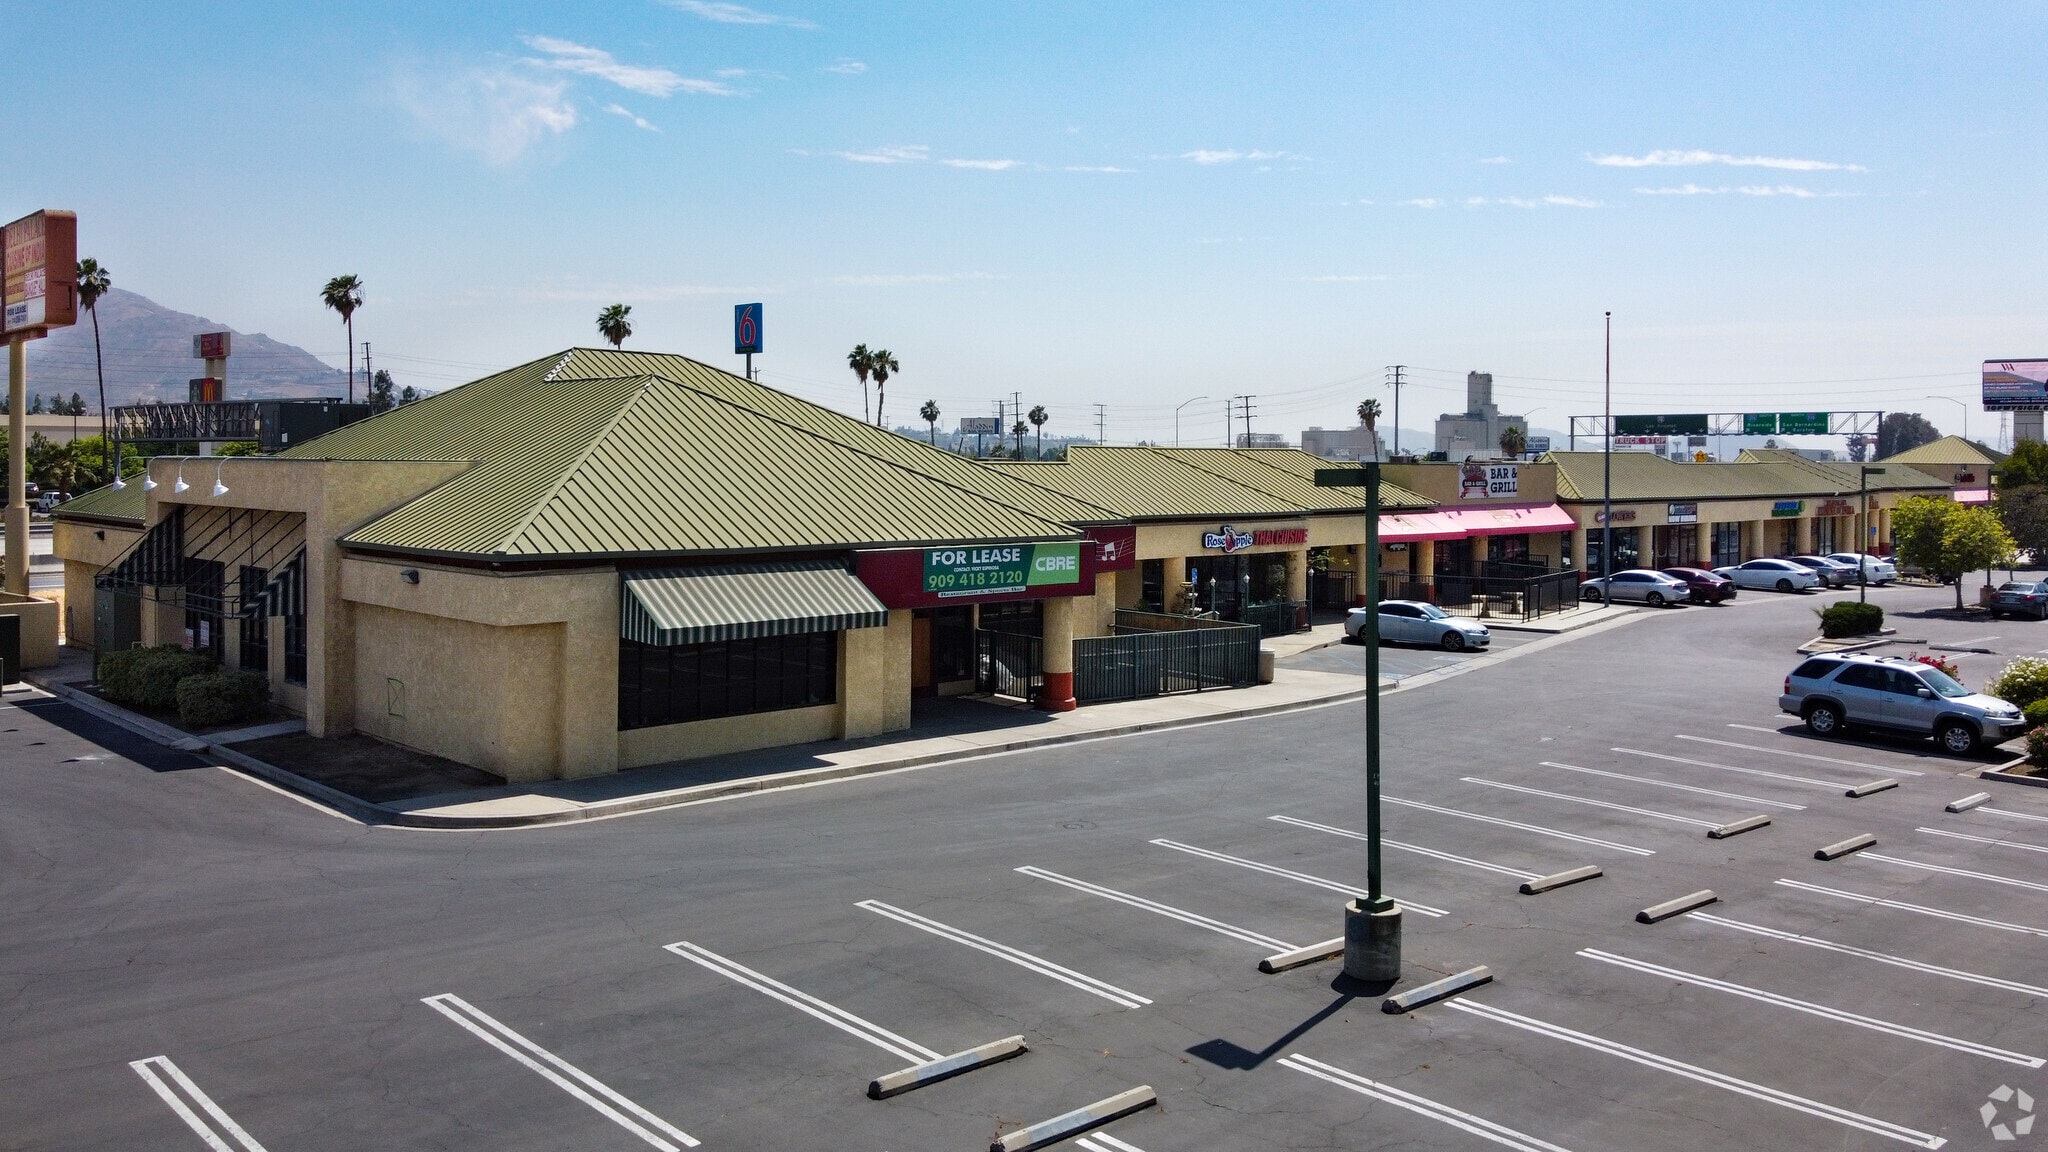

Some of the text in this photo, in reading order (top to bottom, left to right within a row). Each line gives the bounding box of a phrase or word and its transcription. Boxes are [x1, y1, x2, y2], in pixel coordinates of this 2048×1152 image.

[15, 304, 27, 315] LEASE
[739, 305, 757, 347] 6
[1490, 467, 1509, 479] BAR
[1511, 467, 1517, 479] &
[1490, 481, 1517, 493] GRILL
[1207, 534, 1225, 546] Rose
[1254, 528, 1308, 546] THAI CUISINE
[932, 548, 1021, 566] FOR LEASE
[1035, 555, 1076, 572] CBRE
[928, 570, 1023, 588] 909 418 2120
[939, 590, 978, 598] Restaurant
